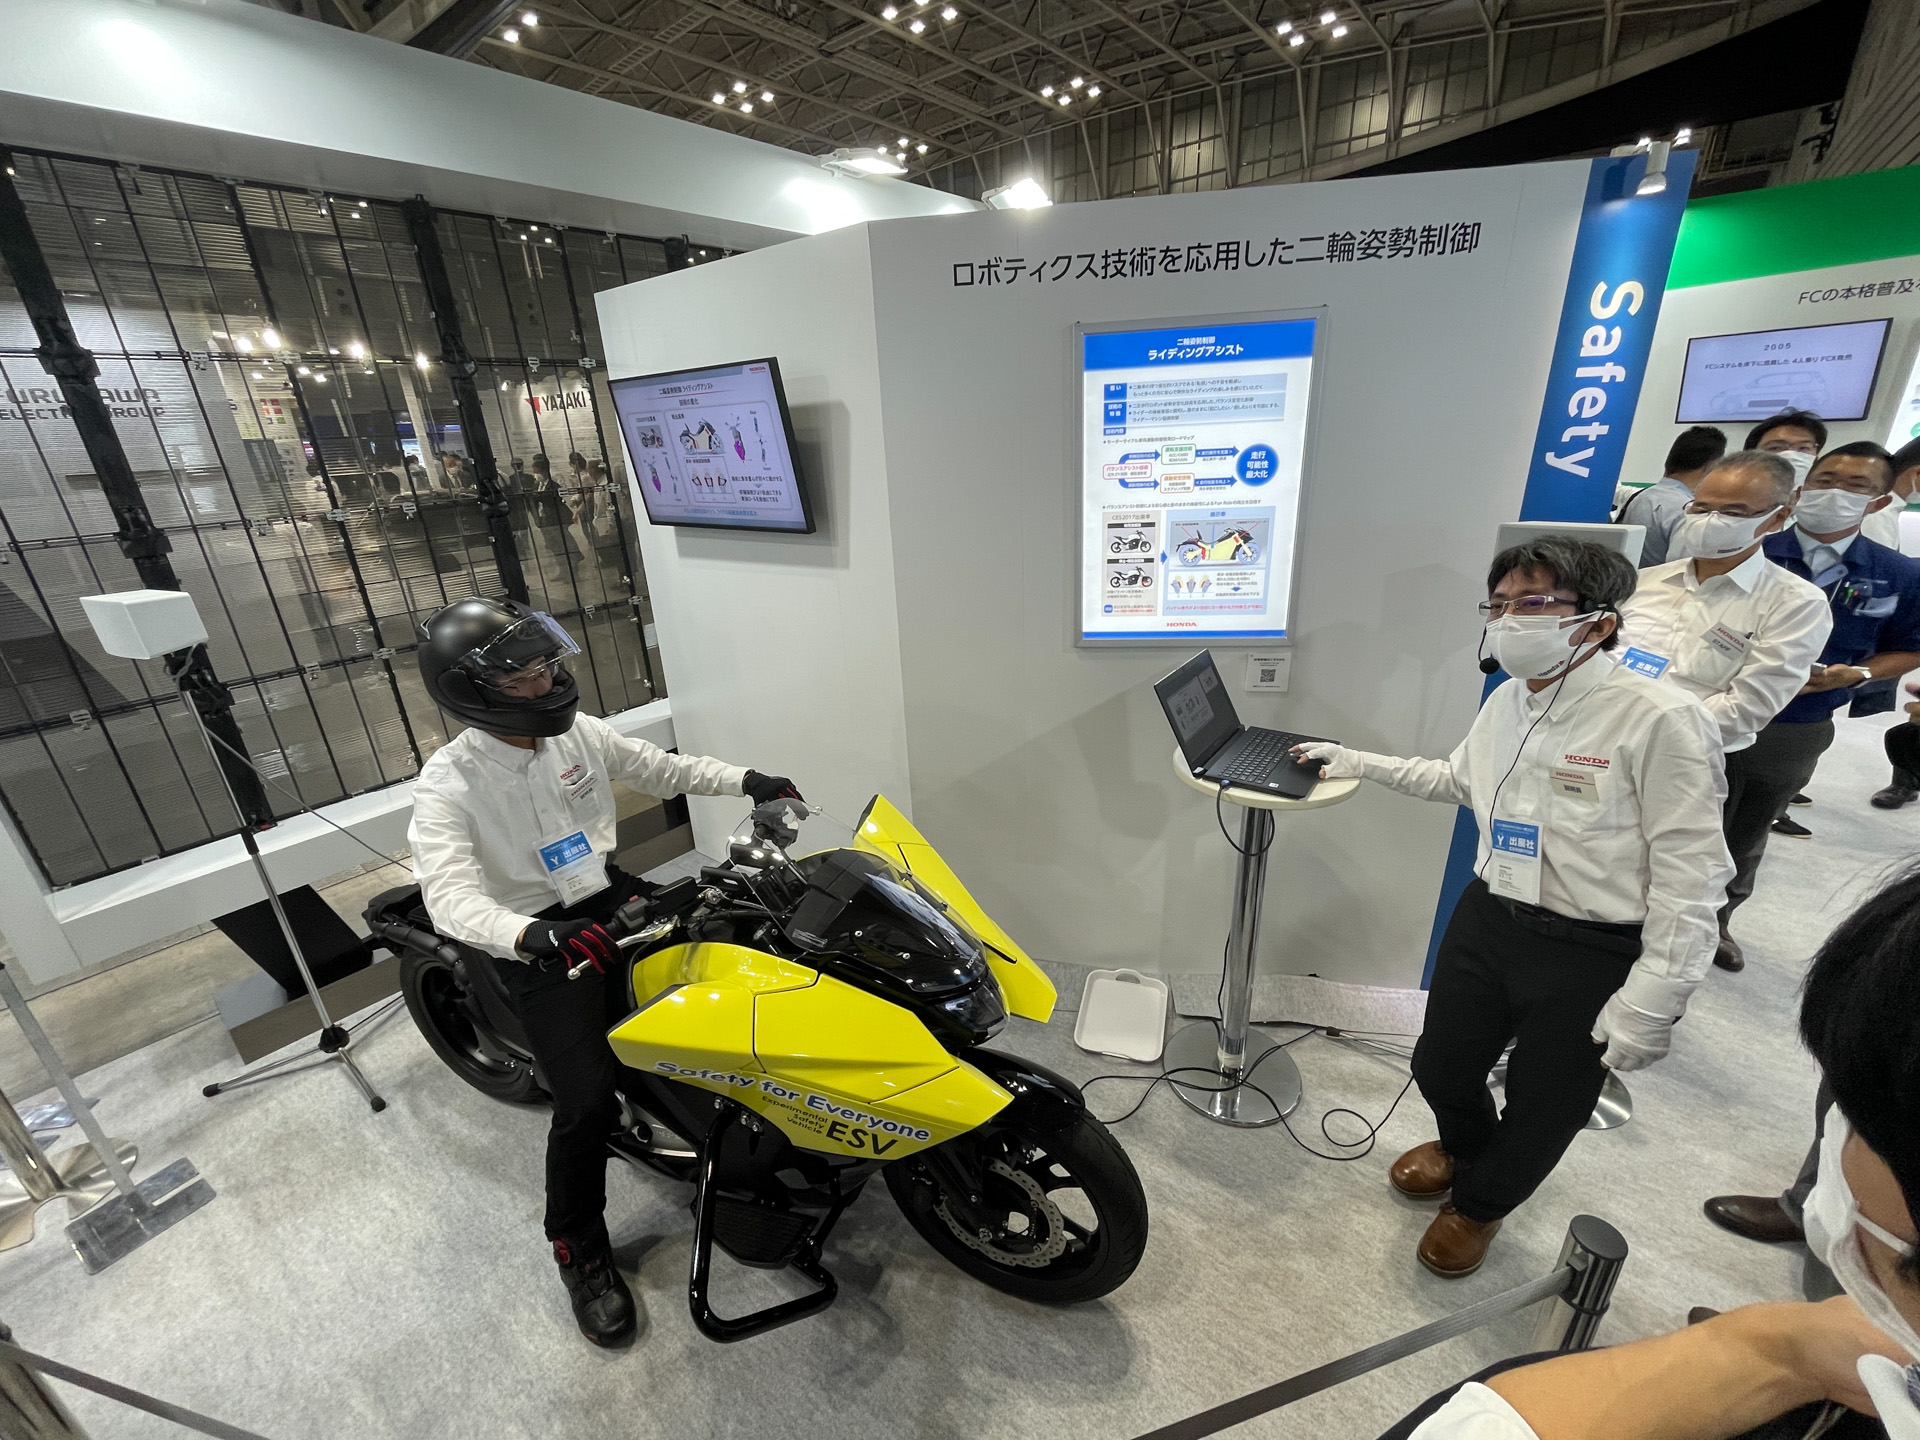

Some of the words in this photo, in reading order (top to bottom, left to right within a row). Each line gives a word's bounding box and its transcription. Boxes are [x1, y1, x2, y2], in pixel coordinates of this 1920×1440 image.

[953, 221, 1483, 288] ロボティクス技術を応用した二輪姿勢制御
[1798, 278, 1920, 305] FCの本格普及
[1148, 343, 1244, 361] ライディングアシスト
[1764, 343, 1792, 351] 2005
[1545, 280, 1645, 478] Safety
[541, 390, 587, 411] YAZAKI
[1251, 451, 1267, 460] 走行
[1246, 461, 1269, 470] 可能性
[1246, 470, 1268, 479] 最大化
[1717, 627, 1745, 648] HONDA
[1537, 664, 1560, 677] Honda
[1564, 754, 1610, 766] HONDA
[1556, 771, 1585, 780] HONDA
[571, 777, 594, 796] HONDA
[656, 1062, 755, 1087] Safety
[762, 1080, 801, 1100] for
[807, 1094, 930, 1140] Everyone
[762, 1096, 828, 1124] Experimental
[786, 1116, 823, 1134] Vehicle
[793, 1113, 825, 1129] Safety
[826, 1120, 899, 1156] ESV
